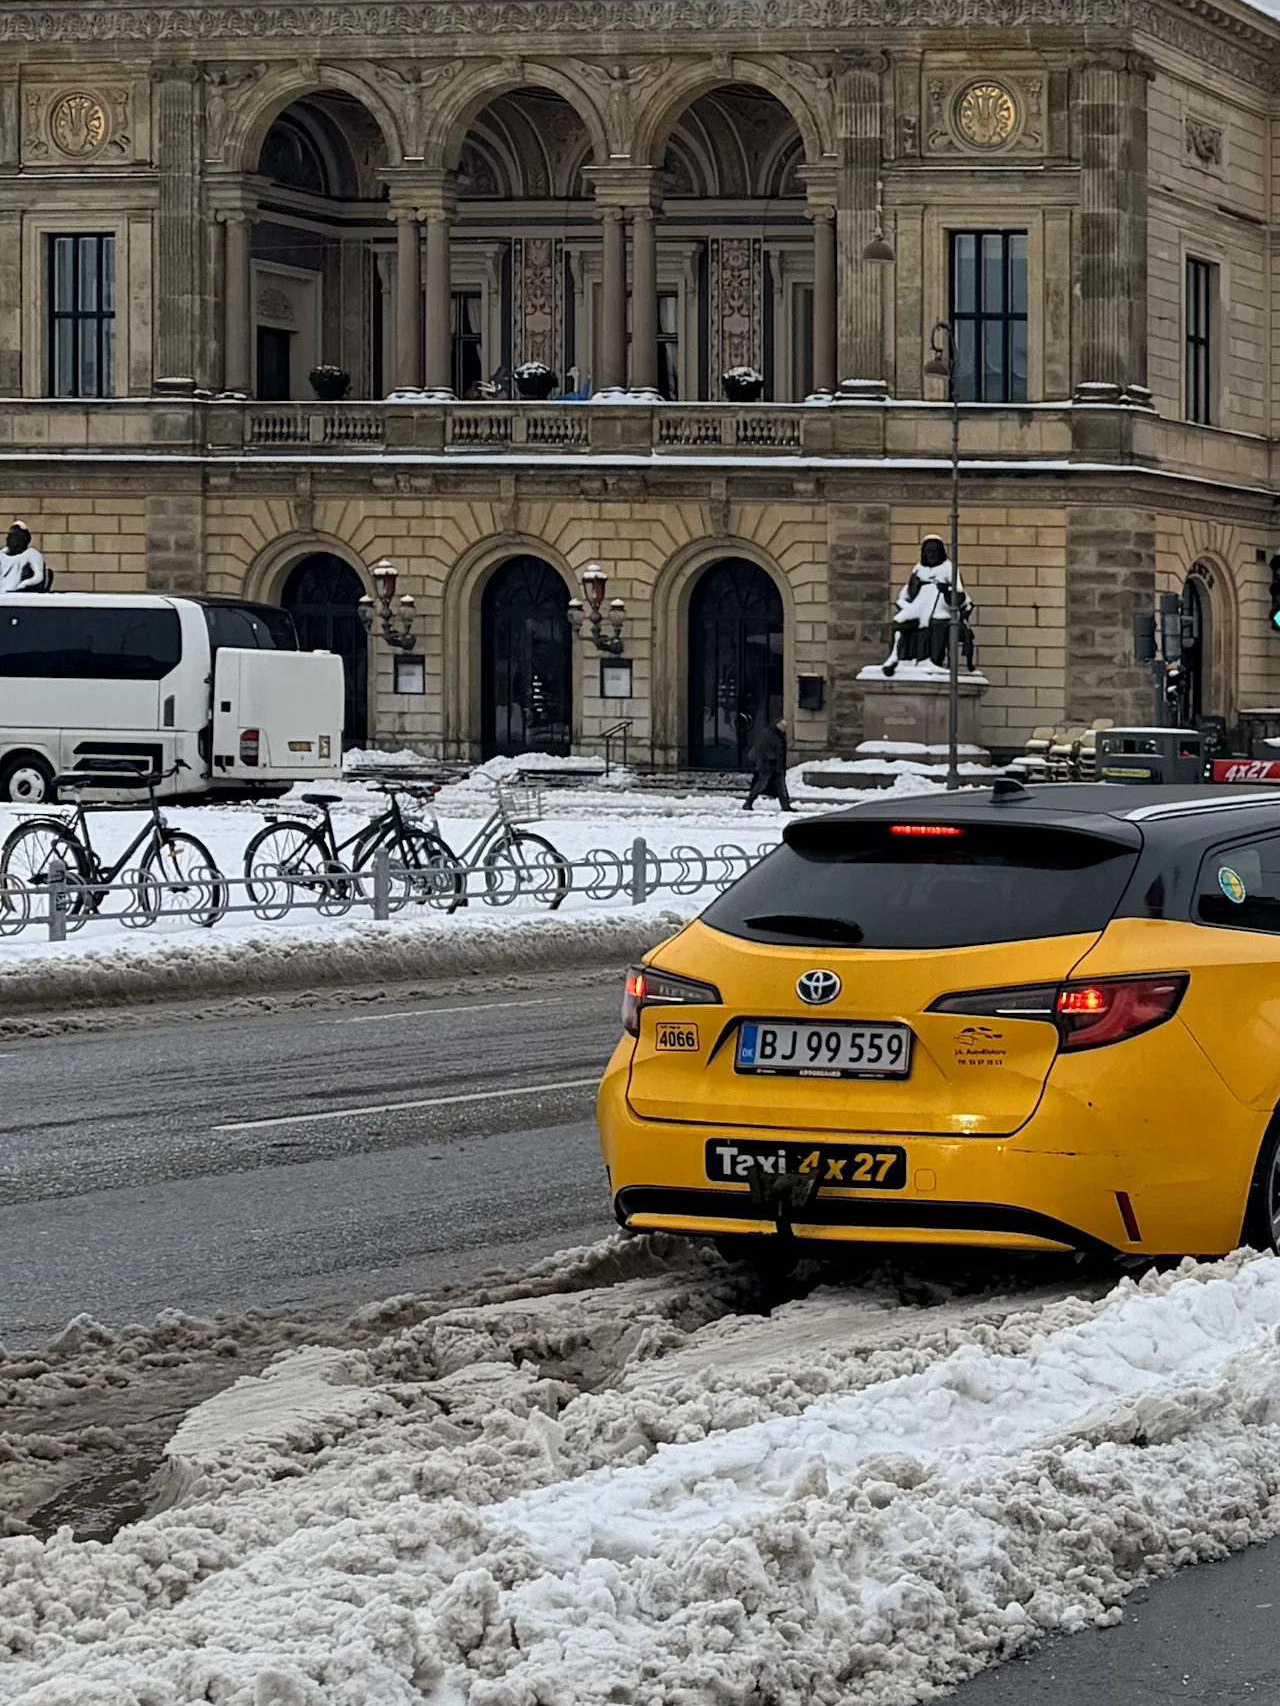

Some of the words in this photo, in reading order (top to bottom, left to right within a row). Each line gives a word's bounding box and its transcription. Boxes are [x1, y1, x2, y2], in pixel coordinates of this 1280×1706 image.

[660, 1030, 694, 1047] 4066
[759, 1030, 798, 1061] BJ
[806, 1031, 842, 1063] 99
[848, 1033, 903, 1065] 559
[742, 1049, 753, 1058] DK
[716, 1146, 786, 1176] Taxi
